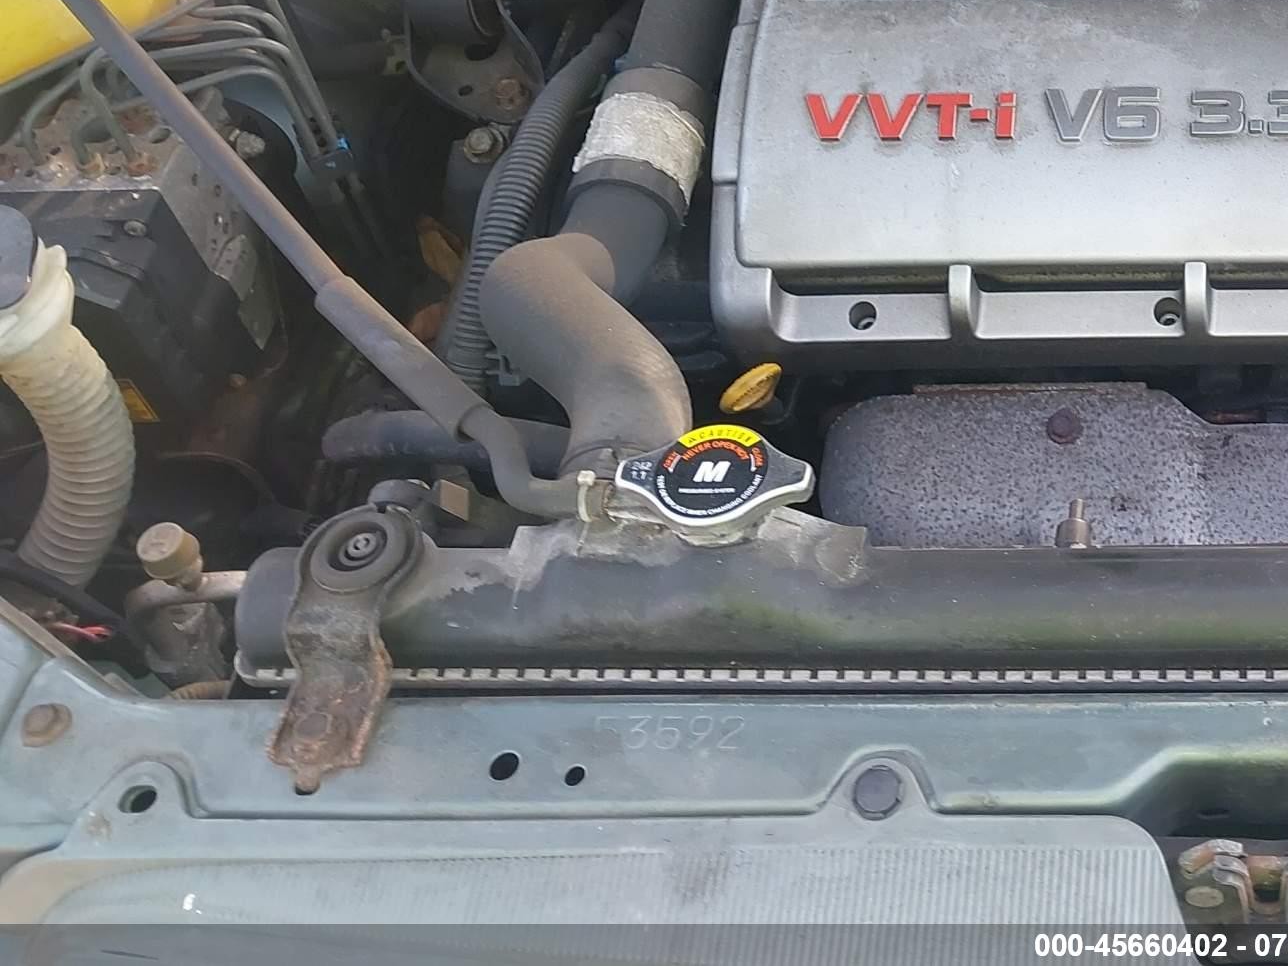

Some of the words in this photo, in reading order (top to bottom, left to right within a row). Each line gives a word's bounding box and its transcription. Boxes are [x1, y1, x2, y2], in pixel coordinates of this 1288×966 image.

[806, 90, 1018, 143] VVT-i
[1045, 85, 1163, 143] V6
[699, 428, 752, 443] CAUTION
[682, 440, 712, 461] NEVER
[740, 474, 764, 501] COOLANT
[595, 714, 745, 750] 53592
